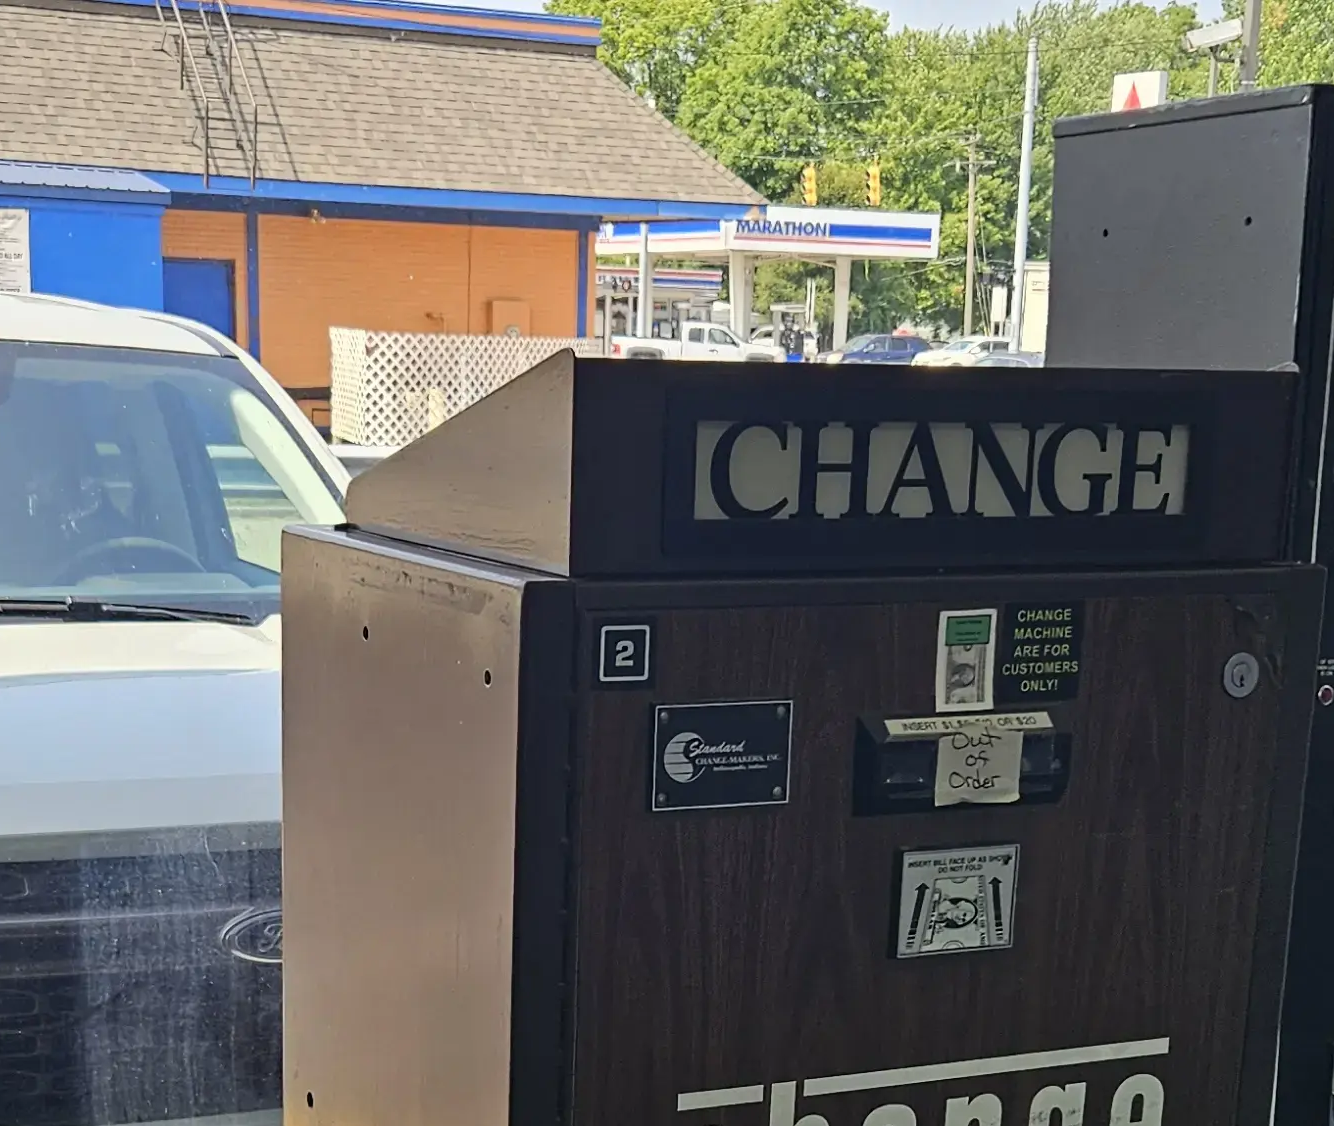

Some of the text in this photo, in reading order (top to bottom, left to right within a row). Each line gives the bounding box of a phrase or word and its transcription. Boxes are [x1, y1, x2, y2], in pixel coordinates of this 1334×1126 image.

[736, 220, 827, 237] MARATHON
[709, 419, 1172, 520] CHANGE
[1017, 608, 1072, 622] CHANGE
[1014, 626, 1072, 640] MACHINE
[615, 640, 635, 667] 2
[1014, 644, 1070, 657] ARE FOR
[1002, 661, 1079, 676] CUSTOMERS
[1020, 679, 1058, 692] ONLY!
[902, 720, 938, 732] INSERT
[998, 717, 1013, 727] OR
[1015, 716, 1037, 726] $20
[951, 728, 1002, 750] Out
[689, 740, 746, 757] Standard
[965, 751, 990, 767] of
[949, 769, 1001, 789] Order
[908, 860, 931, 868] INSERT
[933, 859, 947, 867] BILL
[949, 857, 965, 865] FACE
